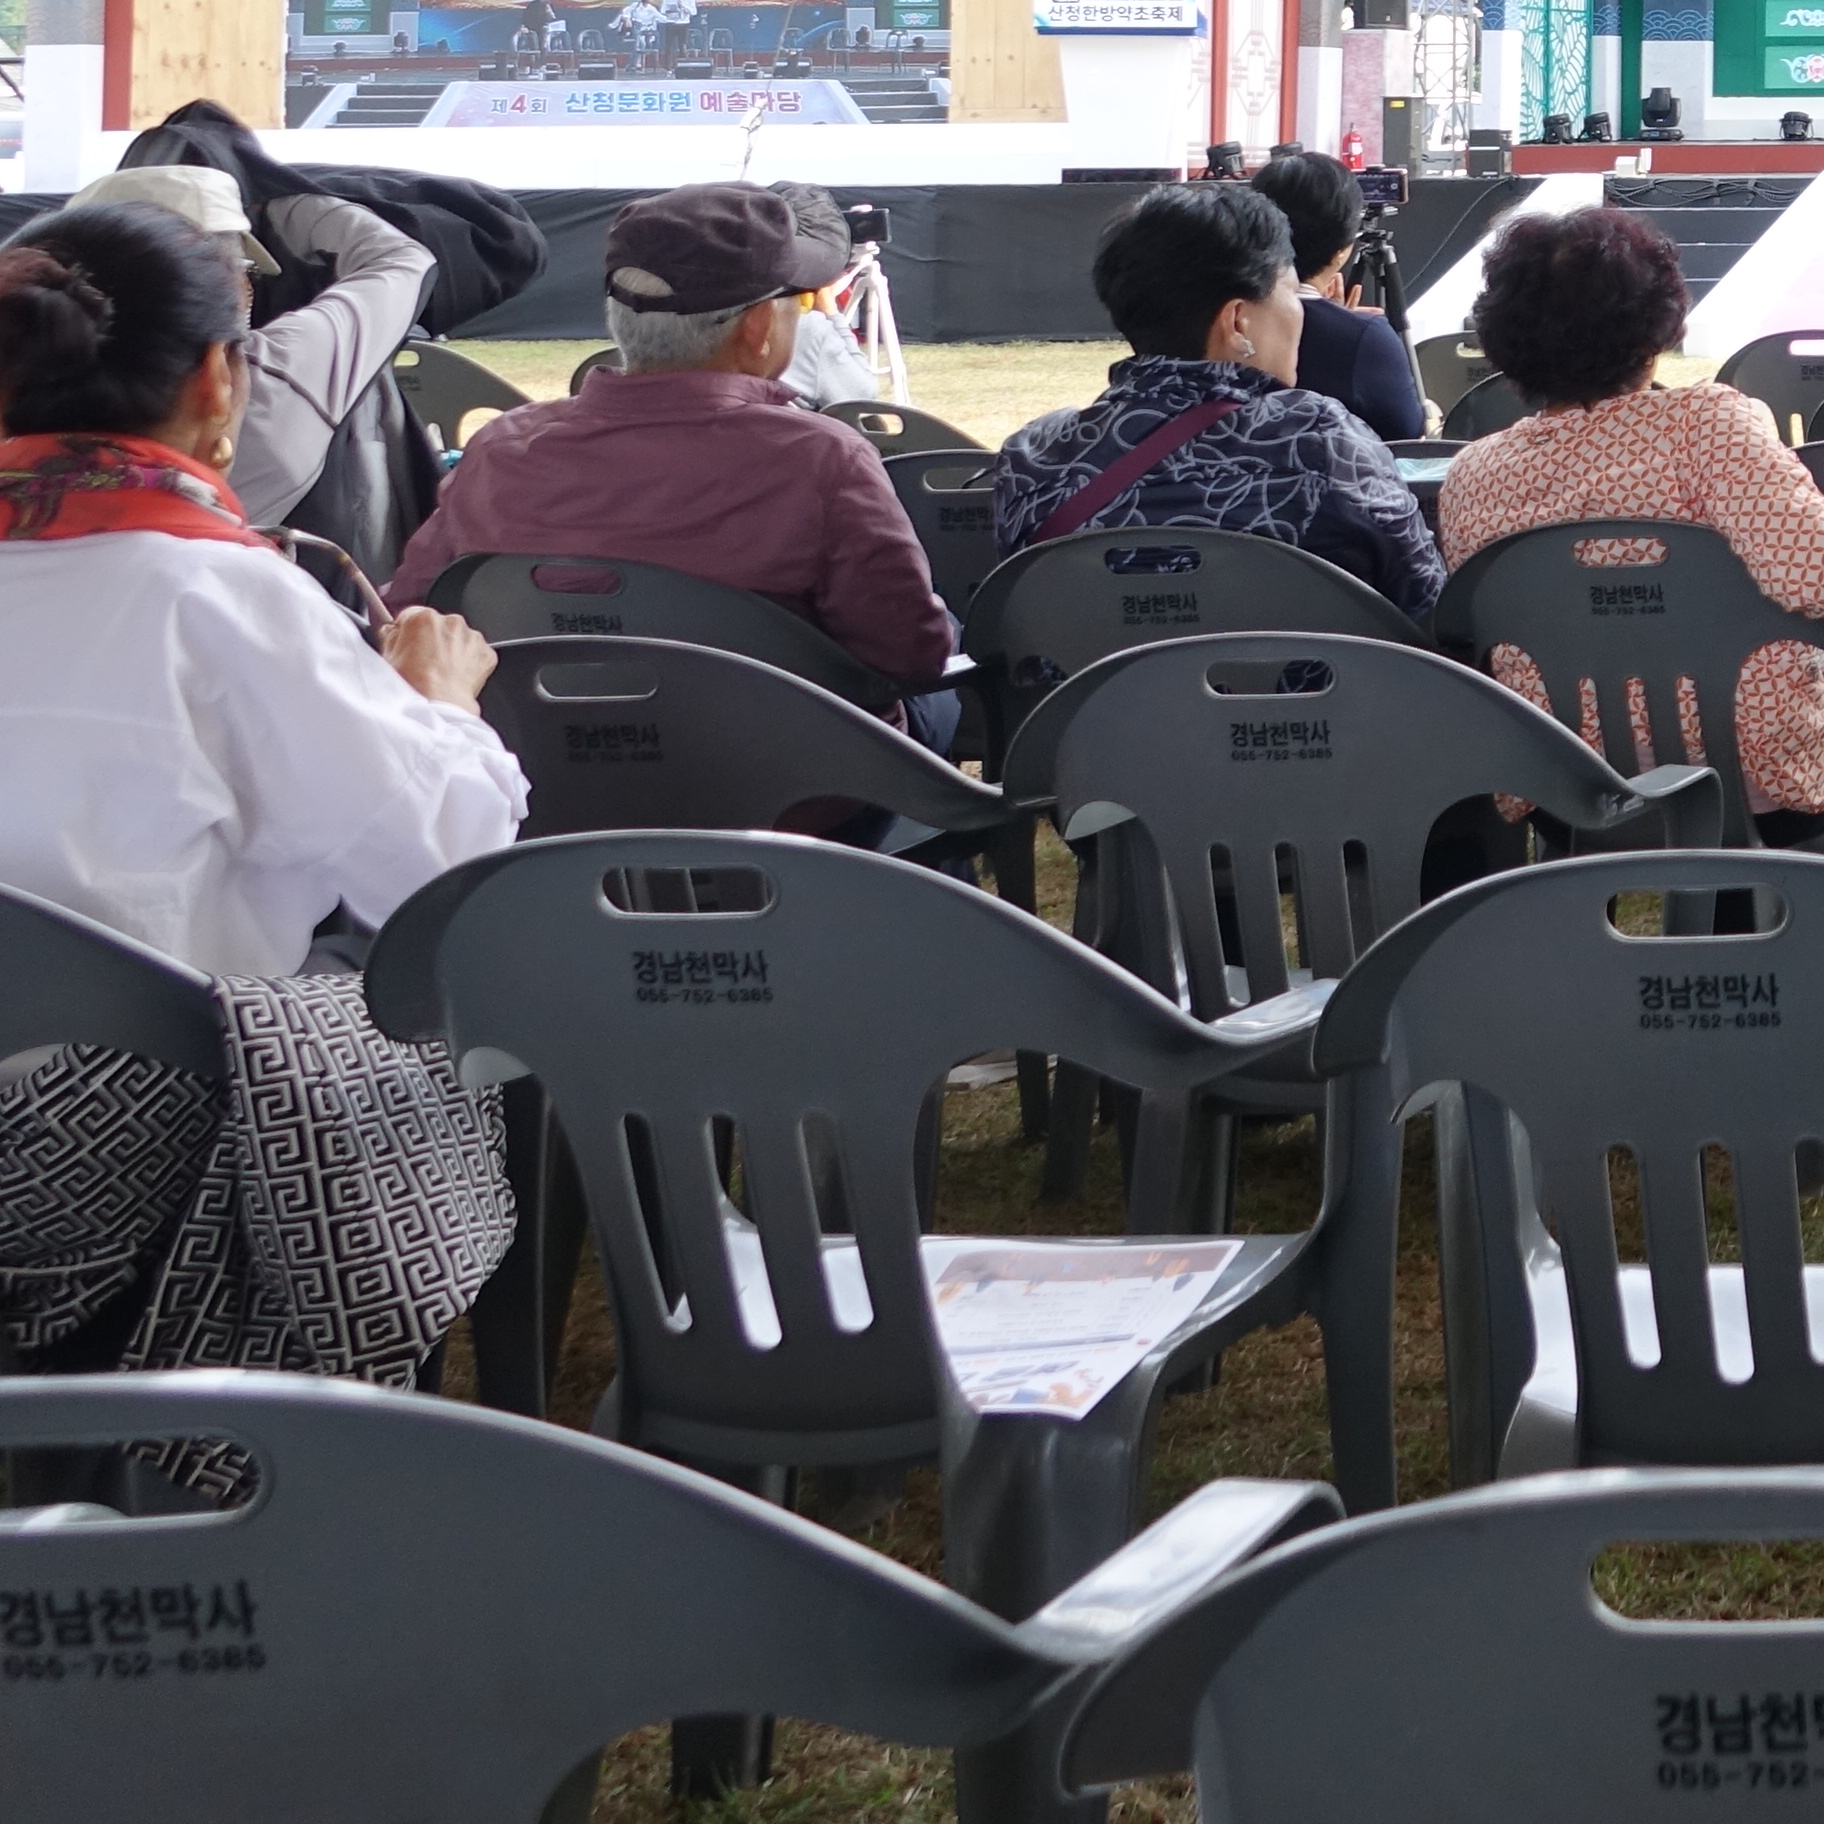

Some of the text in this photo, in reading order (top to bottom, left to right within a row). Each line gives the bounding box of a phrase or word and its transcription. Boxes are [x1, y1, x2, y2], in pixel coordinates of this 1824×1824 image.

[1048, 5, 1183, 22] 산청한방약초축제
[490, 93, 548, 114] 제4회
[565, 90, 692, 114] 산청문화원
[1121, 591, 1198, 614] 경남천막사
[1590, 582, 1664, 605] 경남천막사
[565, 723, 661, 749] 경남천막사
[1230, 719, 1331, 747] 경남천막사
[1230, 747, 1333, 762] 055-752-6385
[632, 948, 769, 985] 경남천막사
[636, 986, 774, 1004] 055-752-6385
[1639, 972, 1780, 1009] 경남천막사
[1639, 1011, 1782, 1030] 055-752-6385
[0, 1578, 258, 1649] 경남천막사
